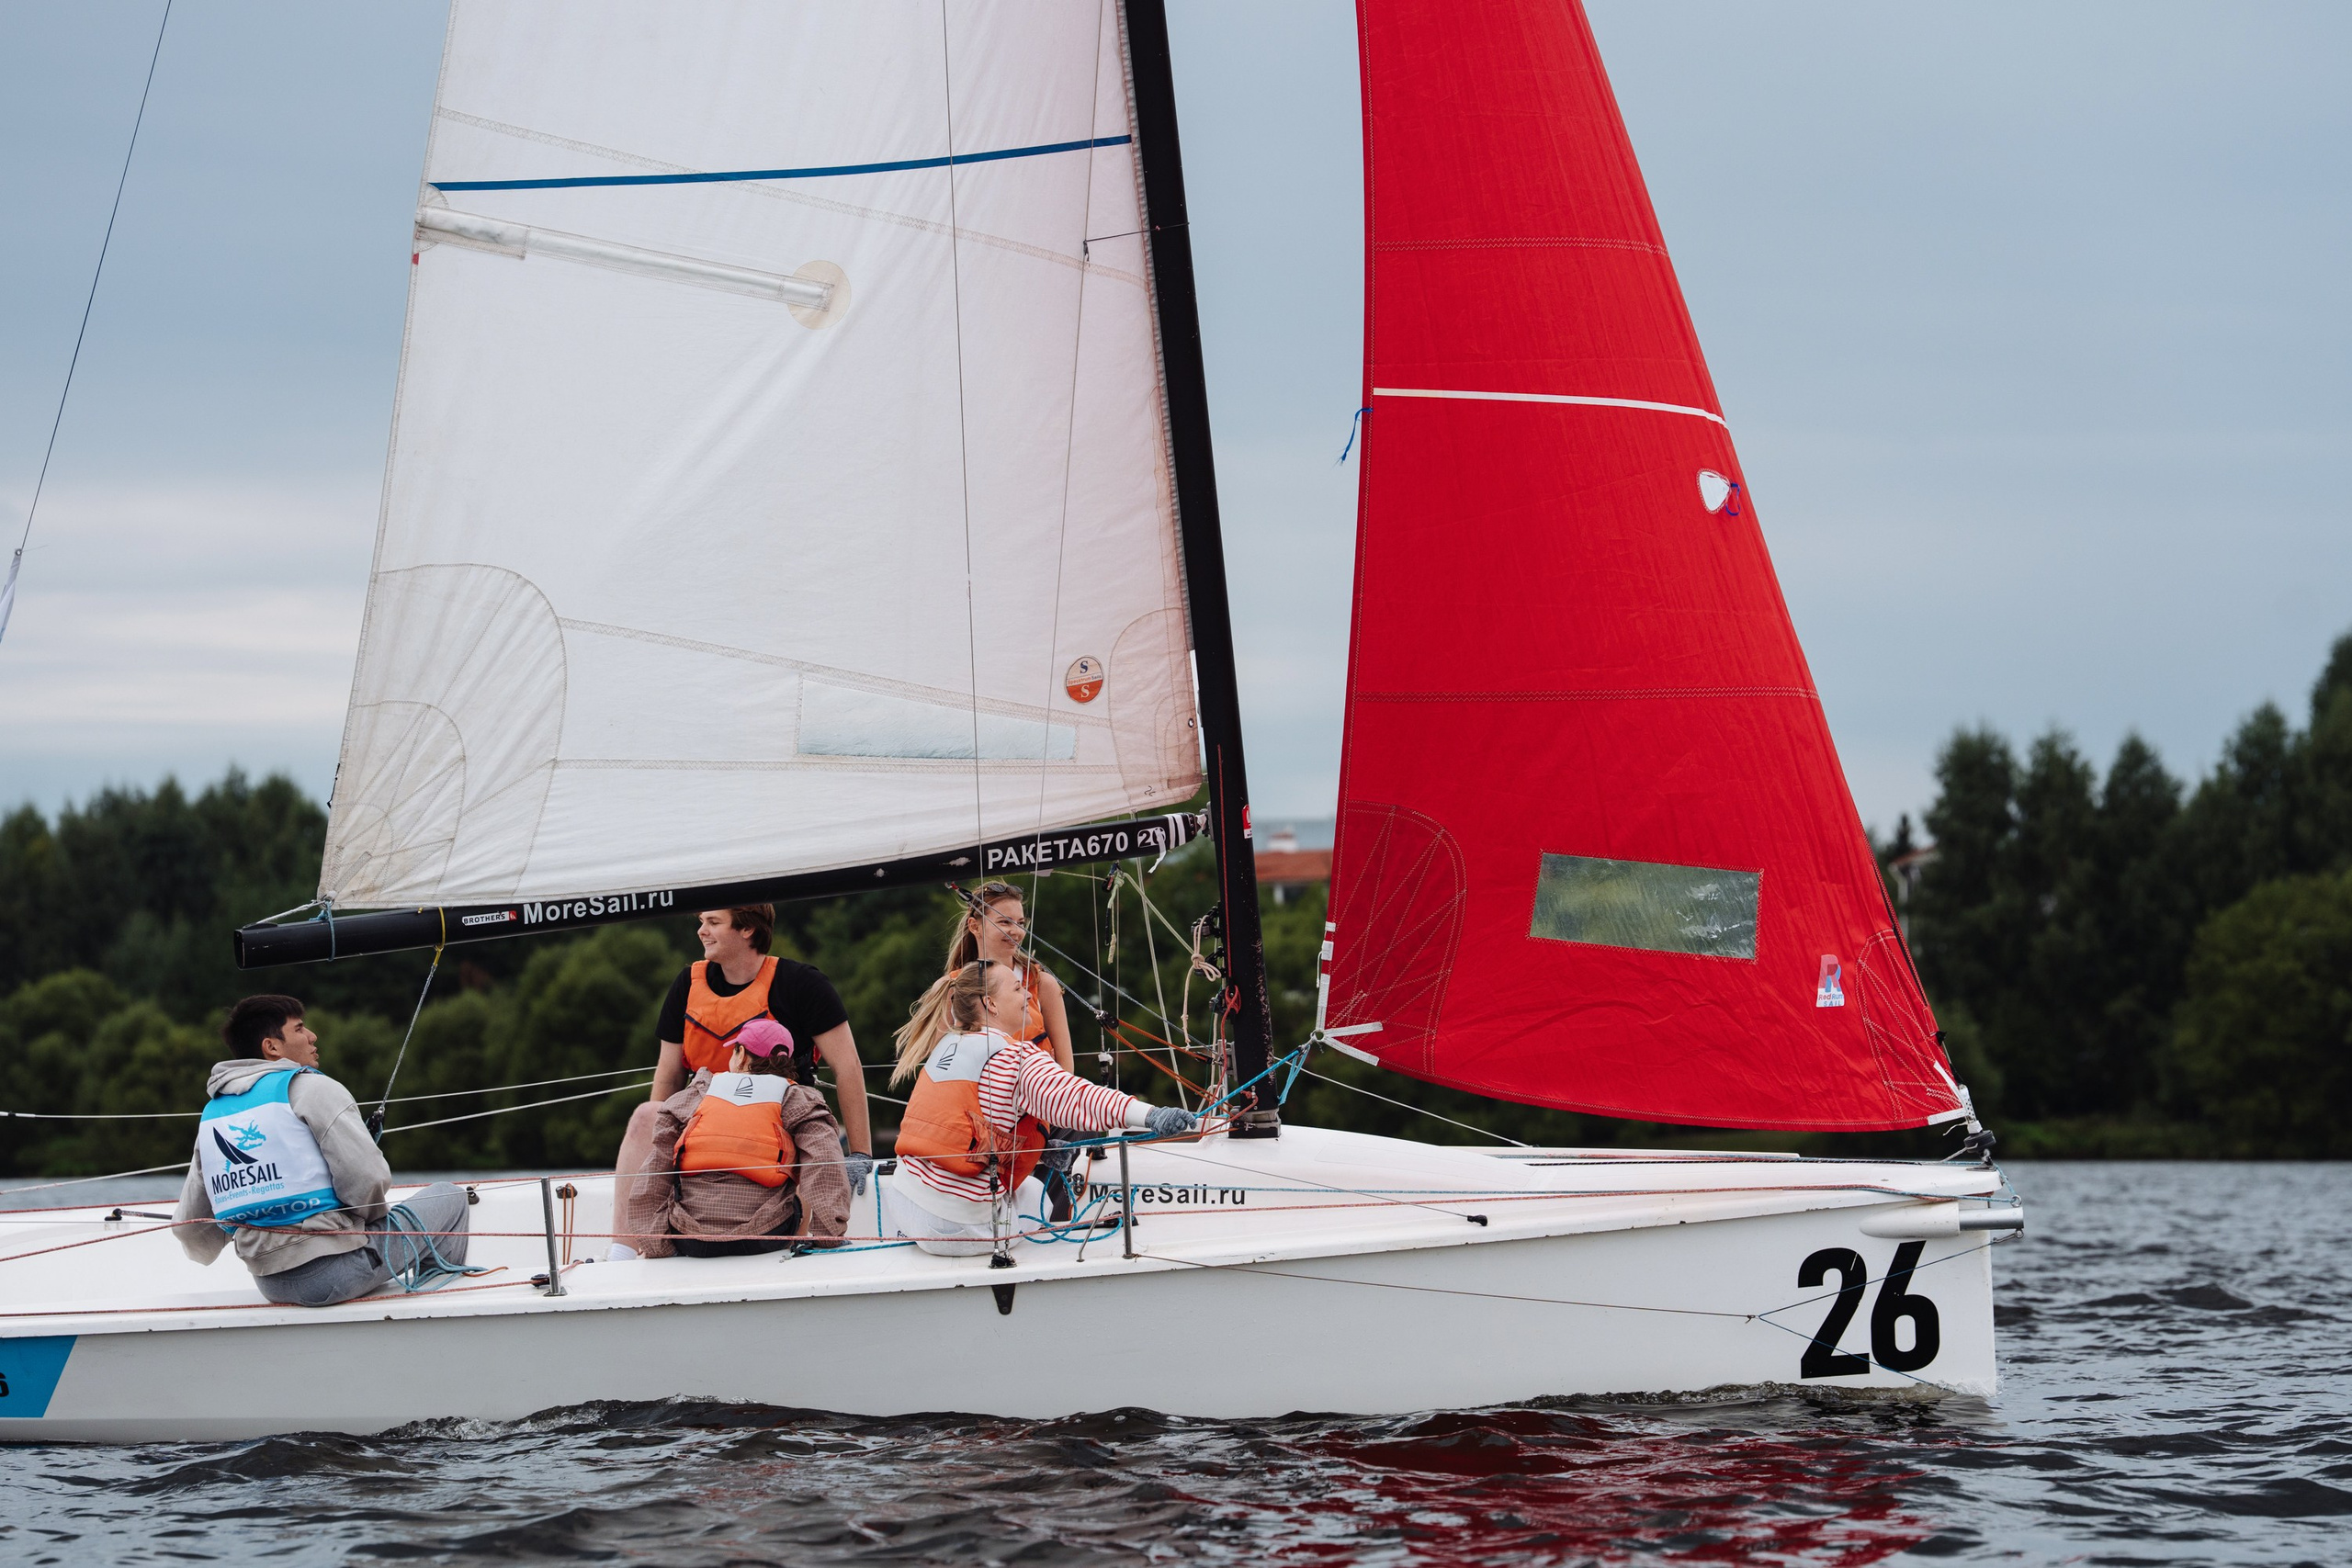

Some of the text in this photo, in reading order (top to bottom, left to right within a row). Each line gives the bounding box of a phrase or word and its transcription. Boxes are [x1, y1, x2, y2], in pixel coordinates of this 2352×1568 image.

[1080, 660, 1088, 673] S
[1080, 684, 1090, 697] S
[523, 890, 674, 925] MoreSail.ru
[463, 913, 505, 924] BROTHERS
[1798, 1240, 1940, 1379] 26
